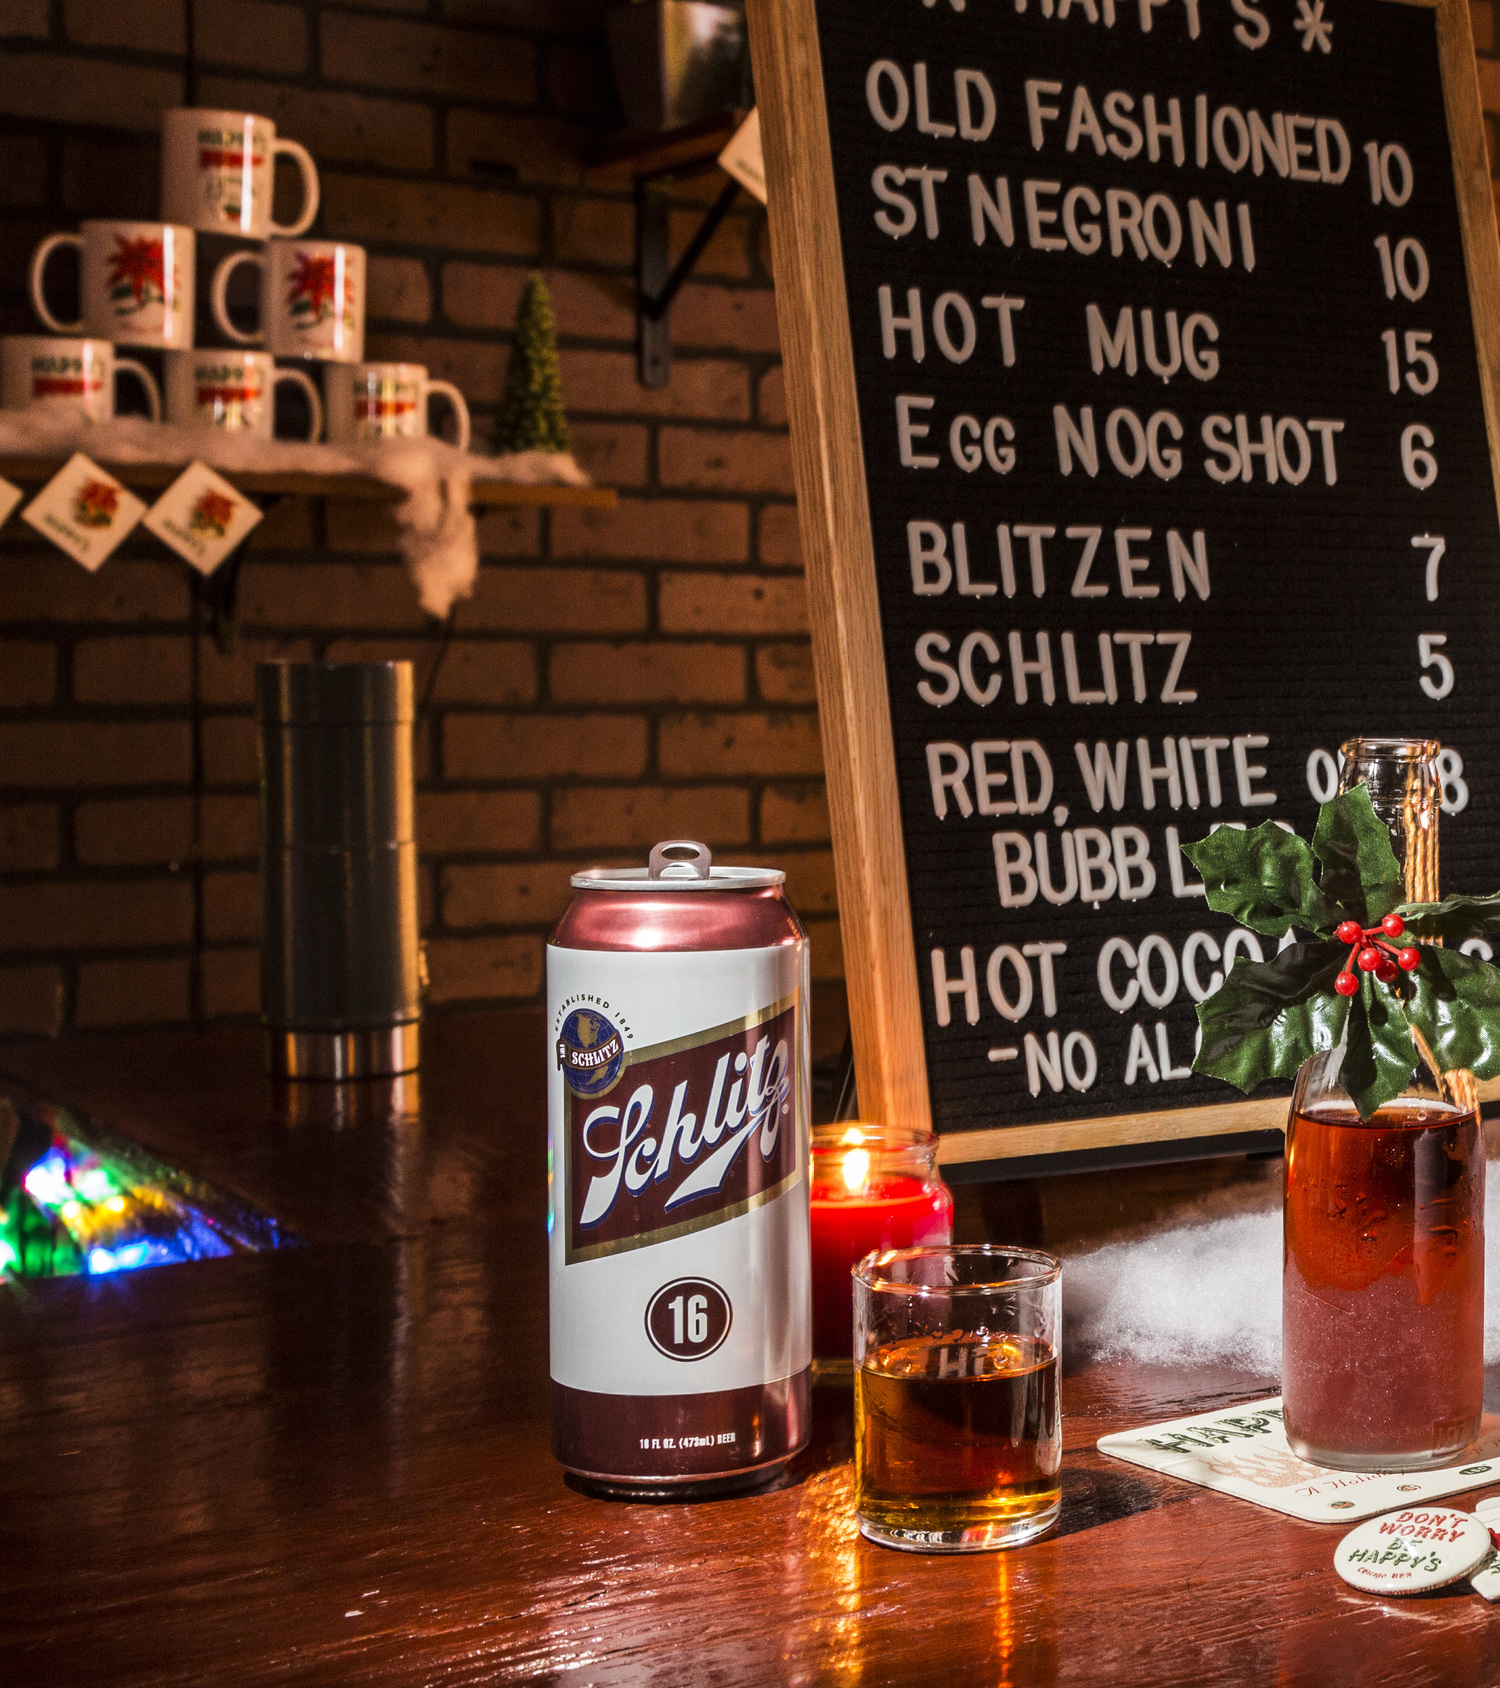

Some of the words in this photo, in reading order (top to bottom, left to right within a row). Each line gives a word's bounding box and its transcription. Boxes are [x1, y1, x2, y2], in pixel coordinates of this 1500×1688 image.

[866, 60, 996, 142] OLD
[1023, 80, 1351, 189] FASHIONED
[1364, 143, 1413, 205] 10
[872, 165, 948, 240] ST
[968, 174, 1255, 272] NEGRONI
[1374, 236, 1429, 302] 10
[878, 286, 1025, 366] HOT
[1086, 304, 1219, 385] MUG
[1381, 330, 1439, 396] 15
[895, 395, 1016, 475] EGG
[1053, 405, 1184, 482] NOG
[1201, 414, 1345, 486] SHOT
[1400, 424, 1438, 491] 6
[906, 521, 1211, 603] BLITZEN
[1410, 532, 1446, 602] 7
[914, 631, 1198, 709] SCHLITZ
[1417, 633, 1455, 701] 5
[925, 740, 1069, 827] RED,
[1074, 733, 1278, 813] WHITE
[1431, 747, 1470, 817] 8
[931, 942, 1067, 1027] HOT
[1097, 928, 1297, 1013] COCO
[571, 1039, 620, 1067] SCHLITZ
[614, 1012, 634, 1039] 1849
[579, 1034, 790, 1231] Schlitz
[667, 1294, 708, 1345] 16
[651, 1438, 661, 1450] FL
[1378, 1522, 1466, 1543] WORRY
[1396, 1511, 1469, 1529] DON'T
[1348, 1549, 1442, 1572] HAPPY'S
